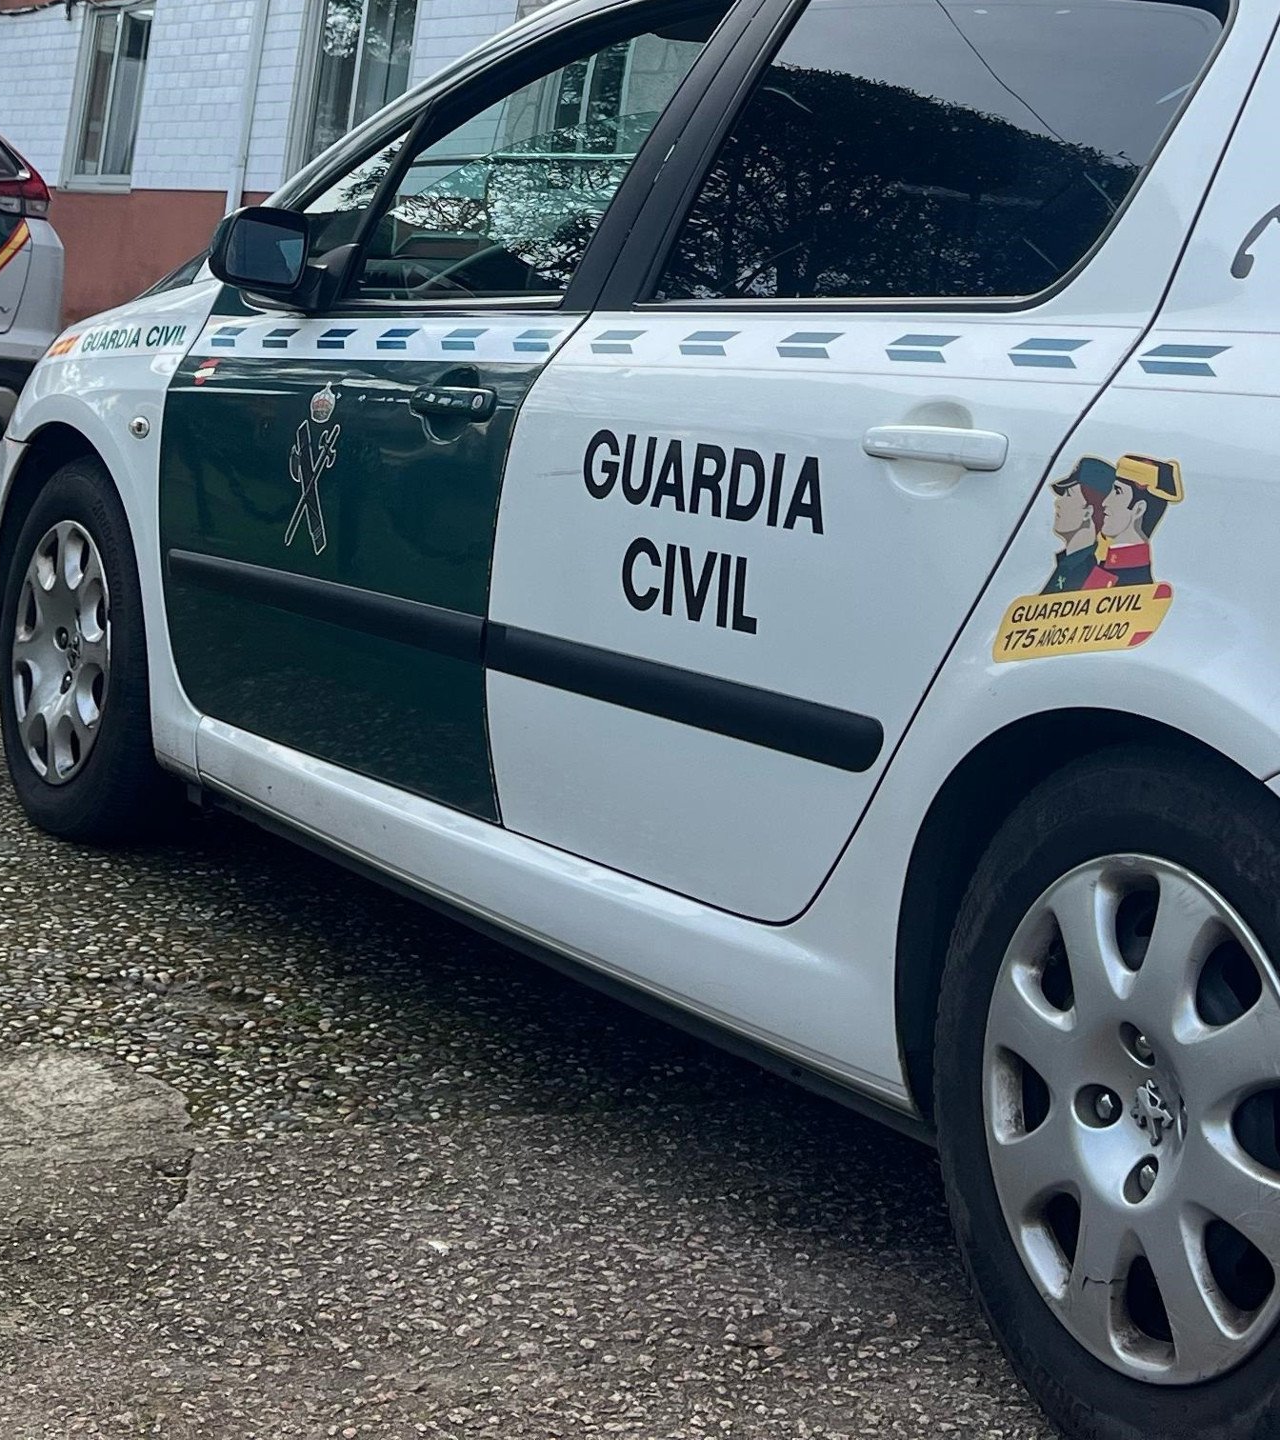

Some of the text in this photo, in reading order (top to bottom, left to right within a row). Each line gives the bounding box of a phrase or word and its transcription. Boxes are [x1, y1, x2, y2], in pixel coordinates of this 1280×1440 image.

[81, 325, 187, 353] GUARDIA CIVIL
[583, 428, 824, 535] GUARDIA
[622, 537, 757, 635] CIVIL
[1011, 594, 1142, 624] GUARDIA CIVIL
[1003, 621, 1130, 651] 175 AÑOS A TU LADO
